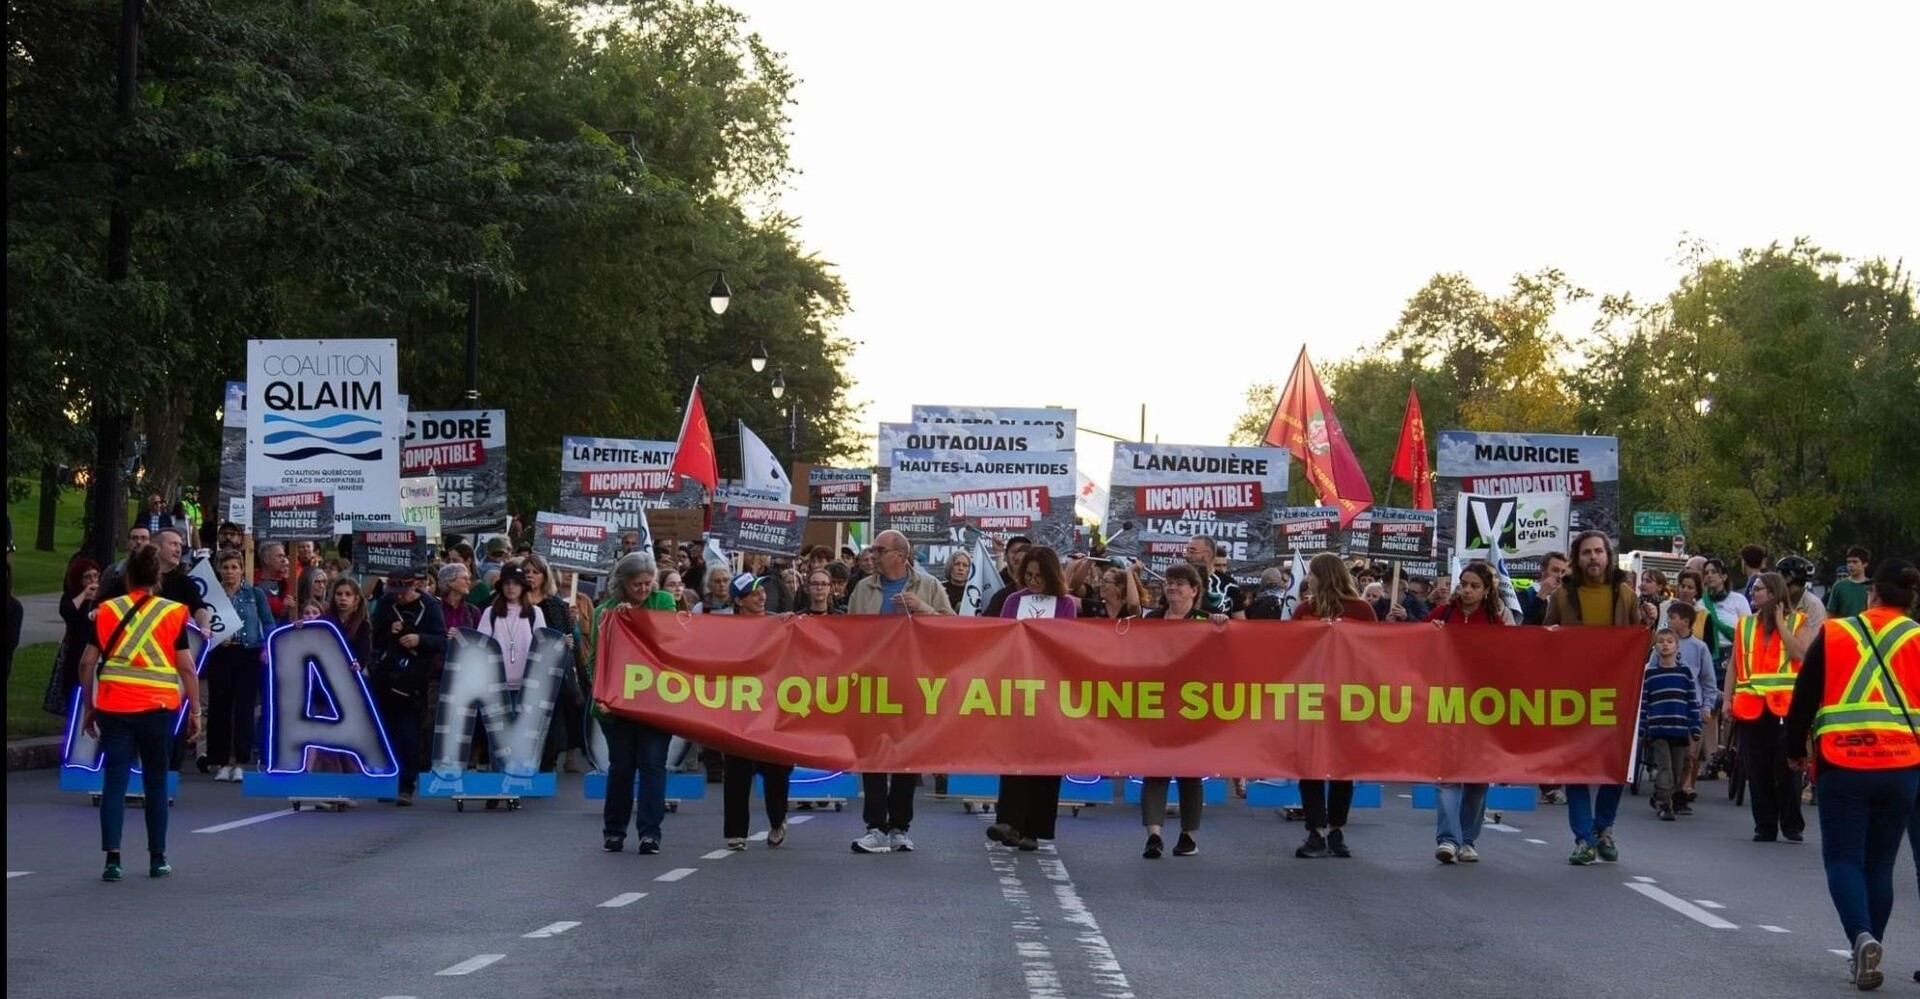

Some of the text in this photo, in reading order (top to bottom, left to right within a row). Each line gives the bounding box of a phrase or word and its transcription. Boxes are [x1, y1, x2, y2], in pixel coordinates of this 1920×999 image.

[263, 354, 382, 376] COALITION
[263, 381, 382, 411] QLAIM
[422, 412, 491, 440] DORÉ
[906, 435, 1028, 451] OUTAOUAIS
[402, 443, 477, 469] OMPATIBLE
[573, 446, 591, 461] LA
[1475, 444, 1580, 464] MAURICIE
[900, 459, 1069, 476] HAUTES-LAURENTIDES
[1133, 453, 1268, 476] LANAUDIÈRE
[590, 471, 675, 491] INCOMPATIBLE
[268, 493, 320, 508] INCOMPATIBLE
[1145, 484, 1254, 511] INCOMPATIBLE
[334, 511, 391, 522] qlaim.com
[741, 508, 792, 522] INCOMPATIBLE
[1181, 509, 1216, 521] AVEC
[1518, 517, 1550, 529] Vent
[551, 524, 603, 539] INCOMPATIBLE
[1147, 517, 1249, 538] L'ACTIVITÉ
[1518, 528, 1557, 541] d'élus
[366, 531, 413, 543] INCOMPATIBLE
[1402, 560, 1437, 569] L'ACTIVIT
[624, 664, 1617, 726] POUR QU'IL Y AIT UNE SUITE DU MONDE
